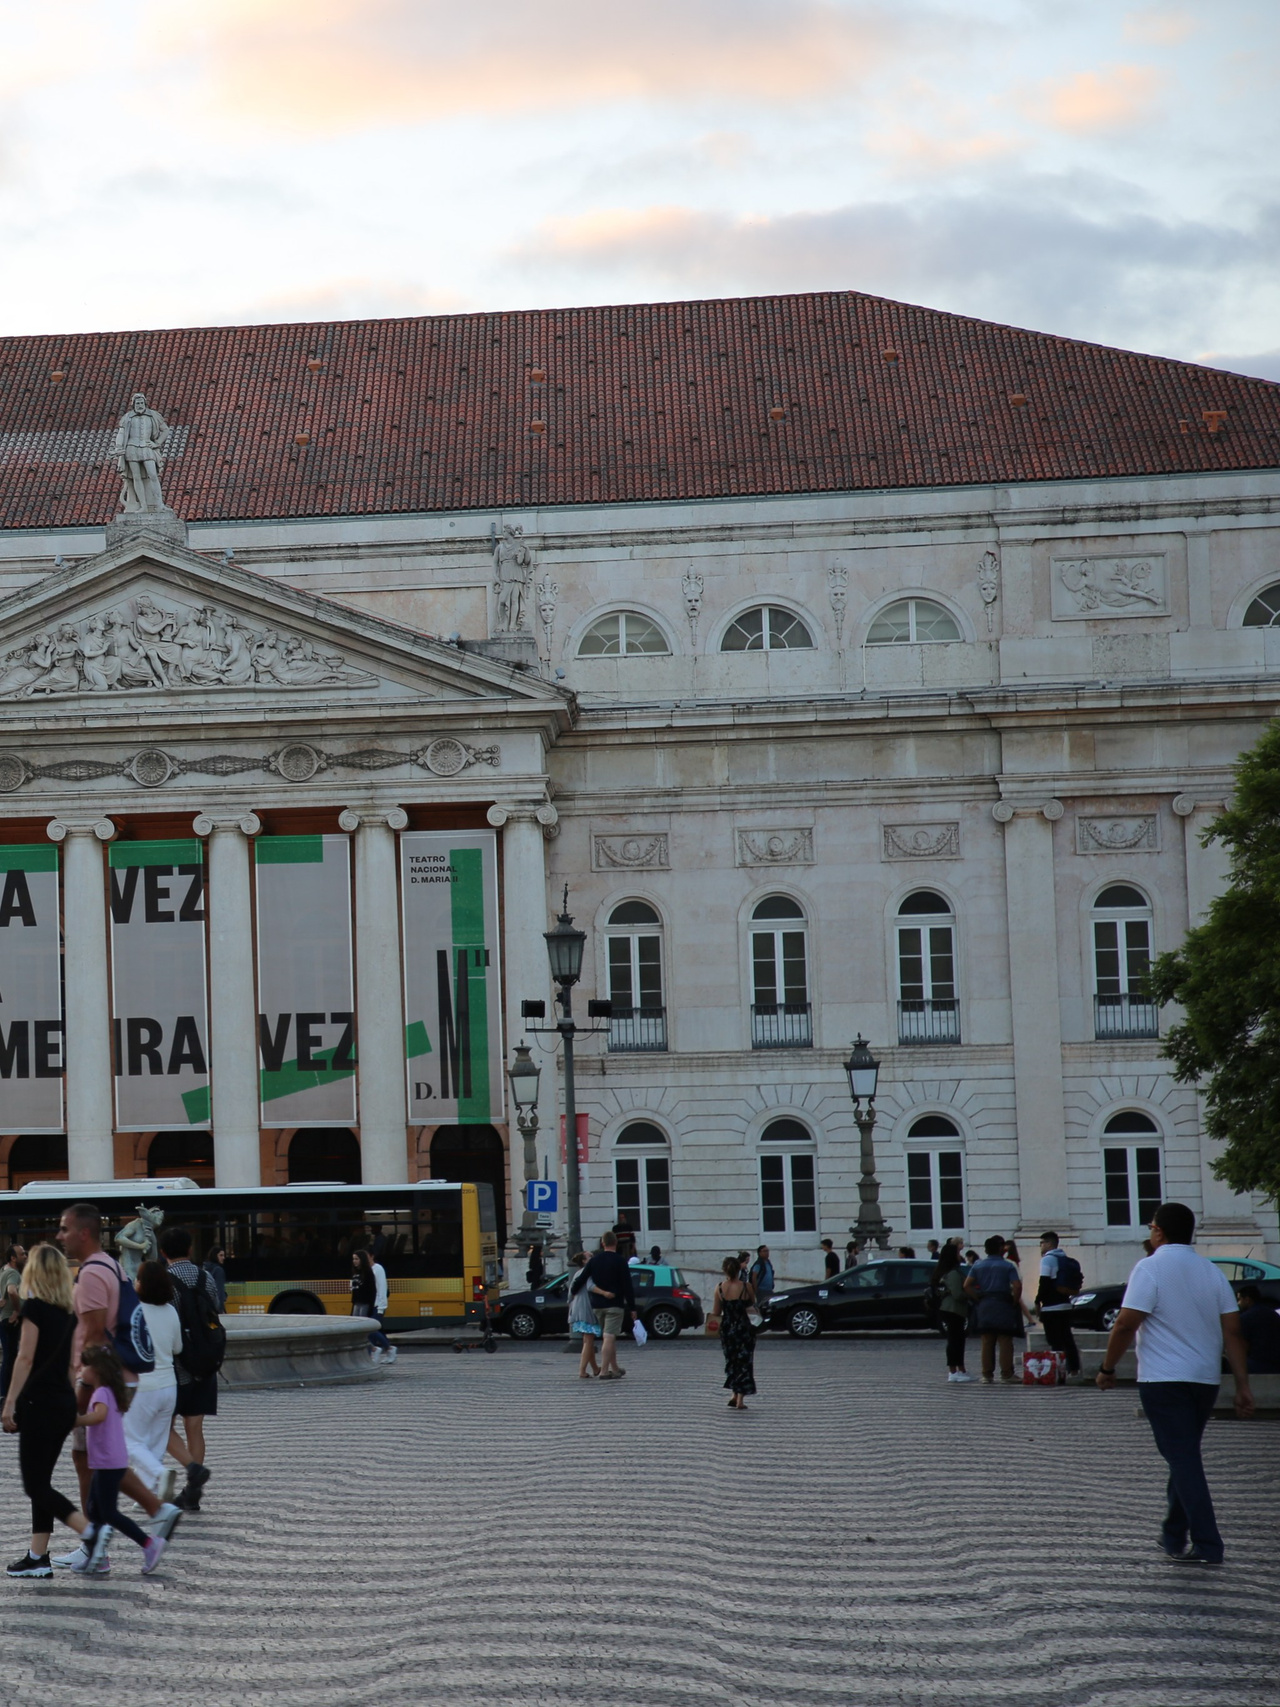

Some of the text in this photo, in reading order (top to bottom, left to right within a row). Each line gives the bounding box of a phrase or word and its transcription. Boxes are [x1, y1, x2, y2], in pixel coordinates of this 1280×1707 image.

[110, 863, 205, 924] VEZ
[258, 1012, 356, 1073] VEZ
[533, 1183, 552, 1209] P
